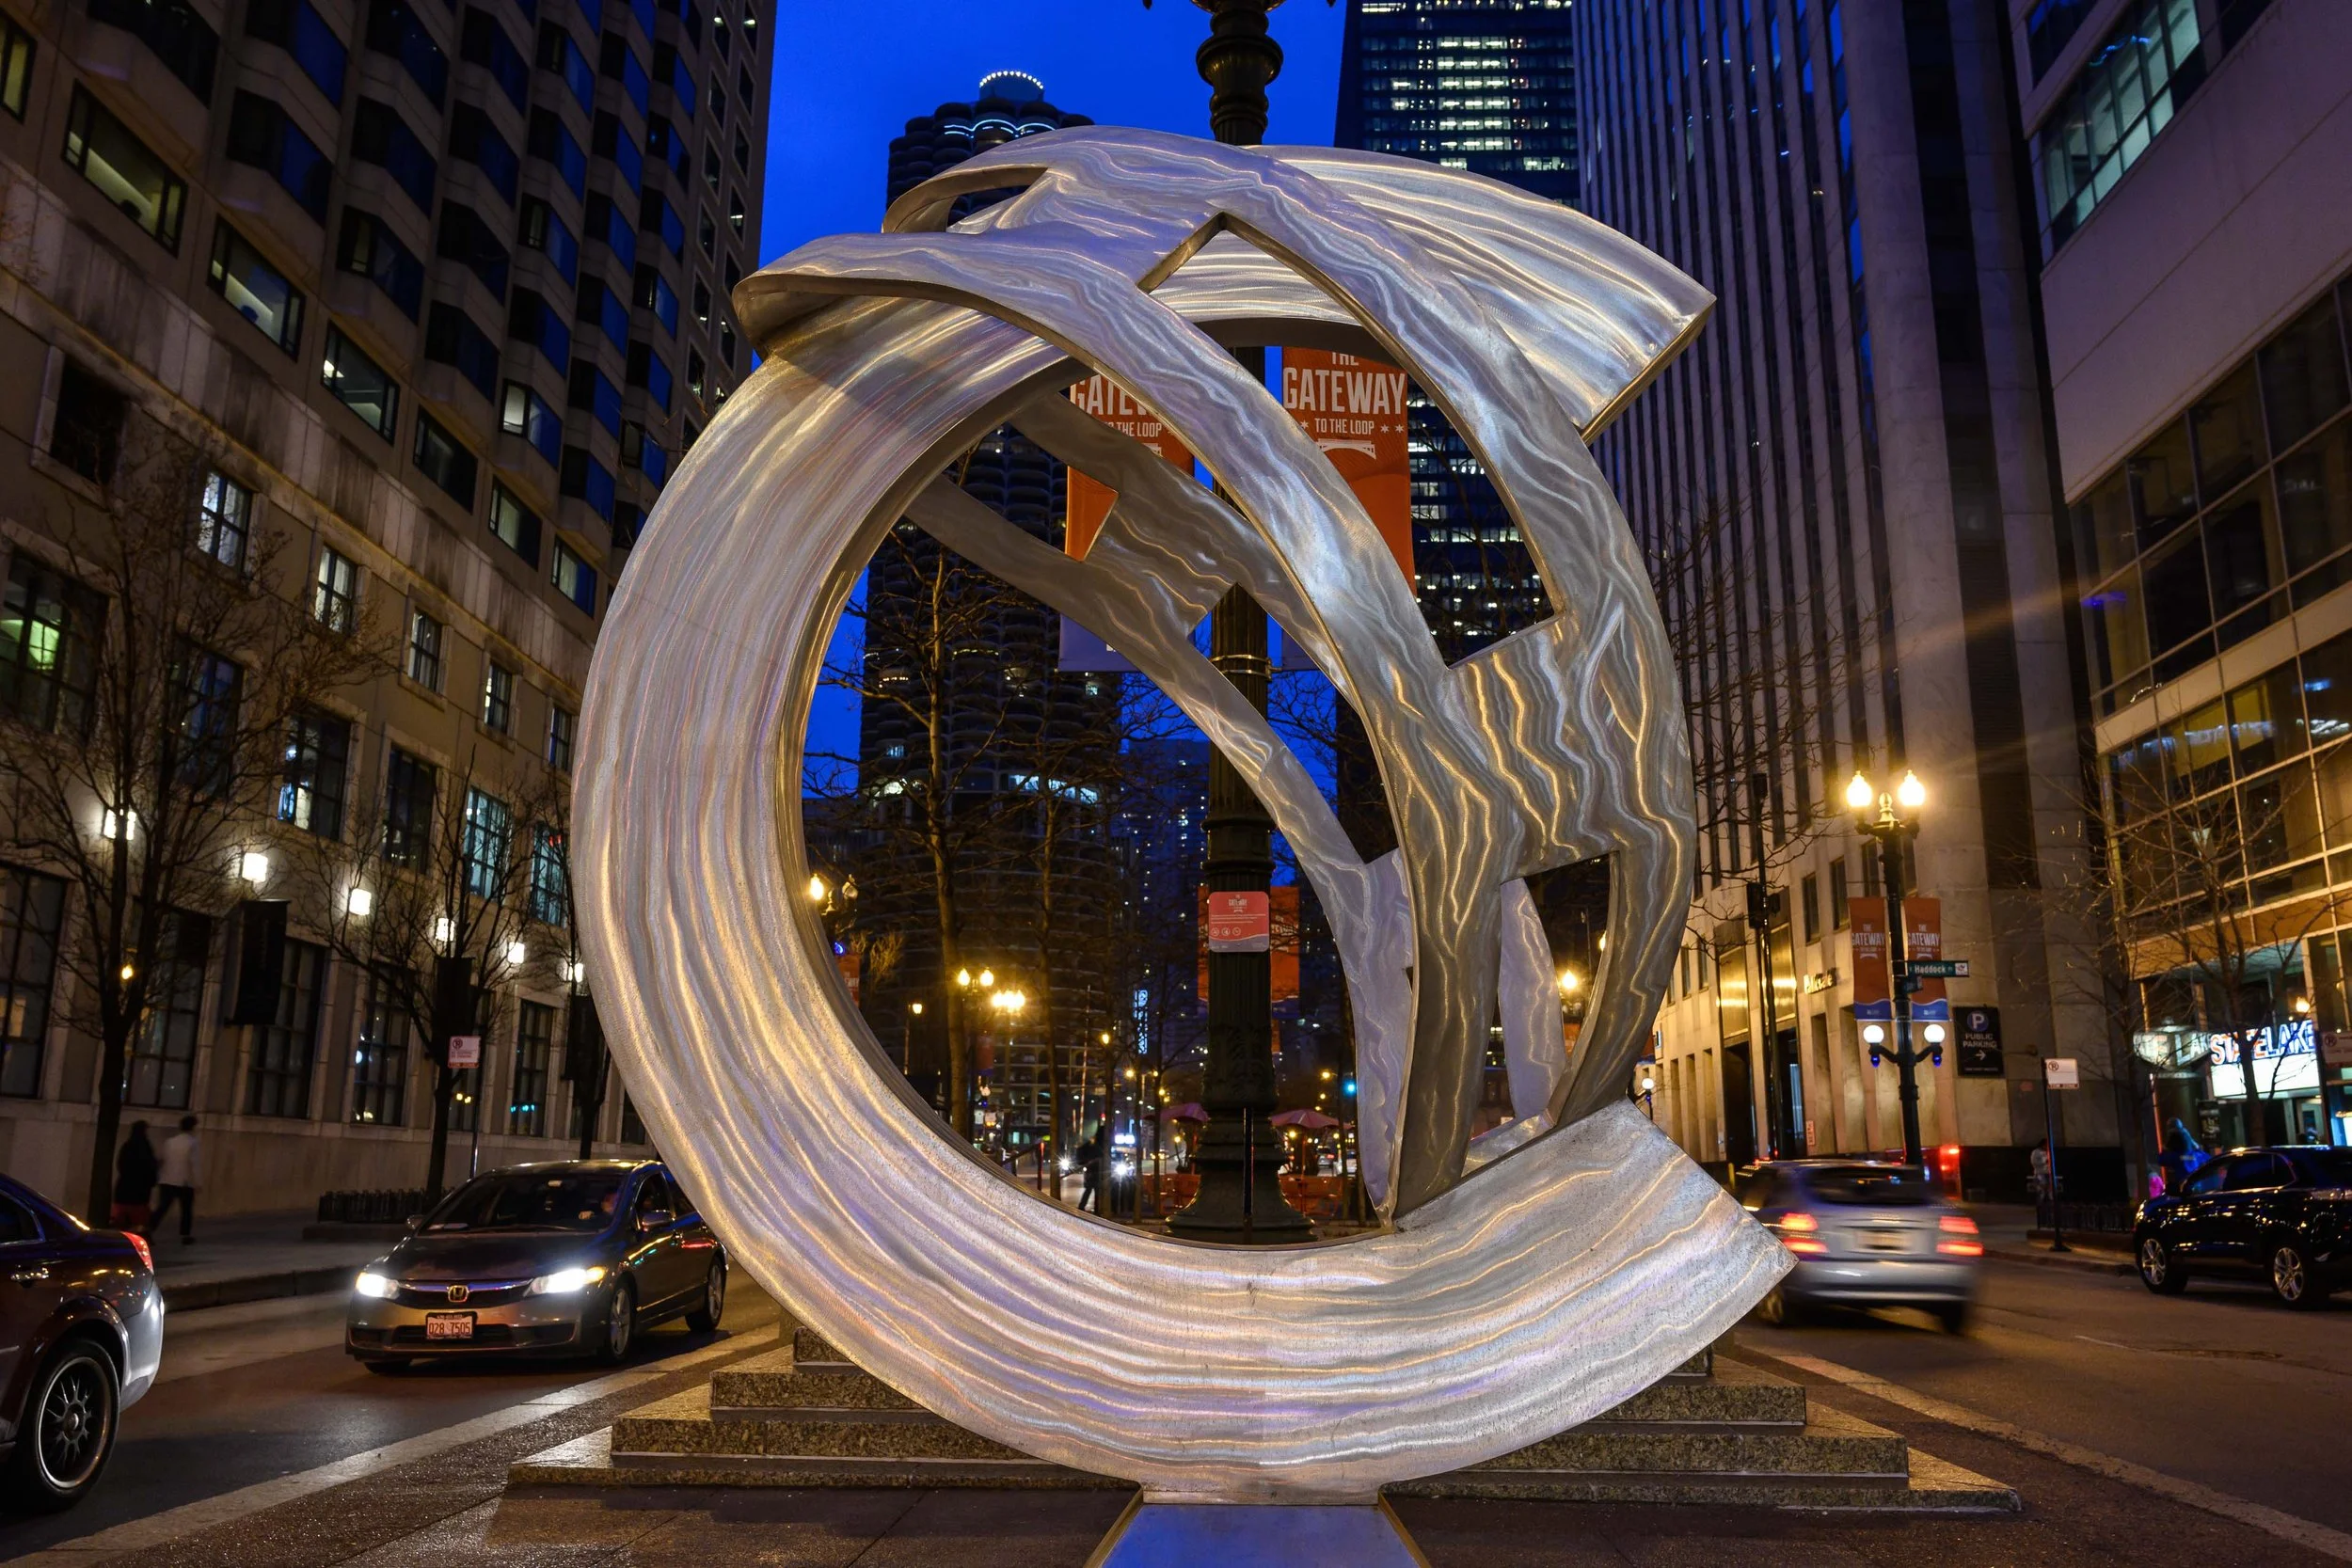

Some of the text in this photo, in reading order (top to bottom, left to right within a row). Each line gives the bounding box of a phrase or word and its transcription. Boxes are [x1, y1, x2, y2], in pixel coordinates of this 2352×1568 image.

[1282, 367, 1406, 415] GATEWAY
[1136, 422, 1162, 437] LOOP
[1314, 418, 1375, 435] TO THE LOOP
[1851, 932, 1885, 946] GATEWAY
[1908, 933, 1941, 946] GATEWAY
[1915, 964, 1947, 974] Haddock
[1971, 1013, 1985, 1029] P
